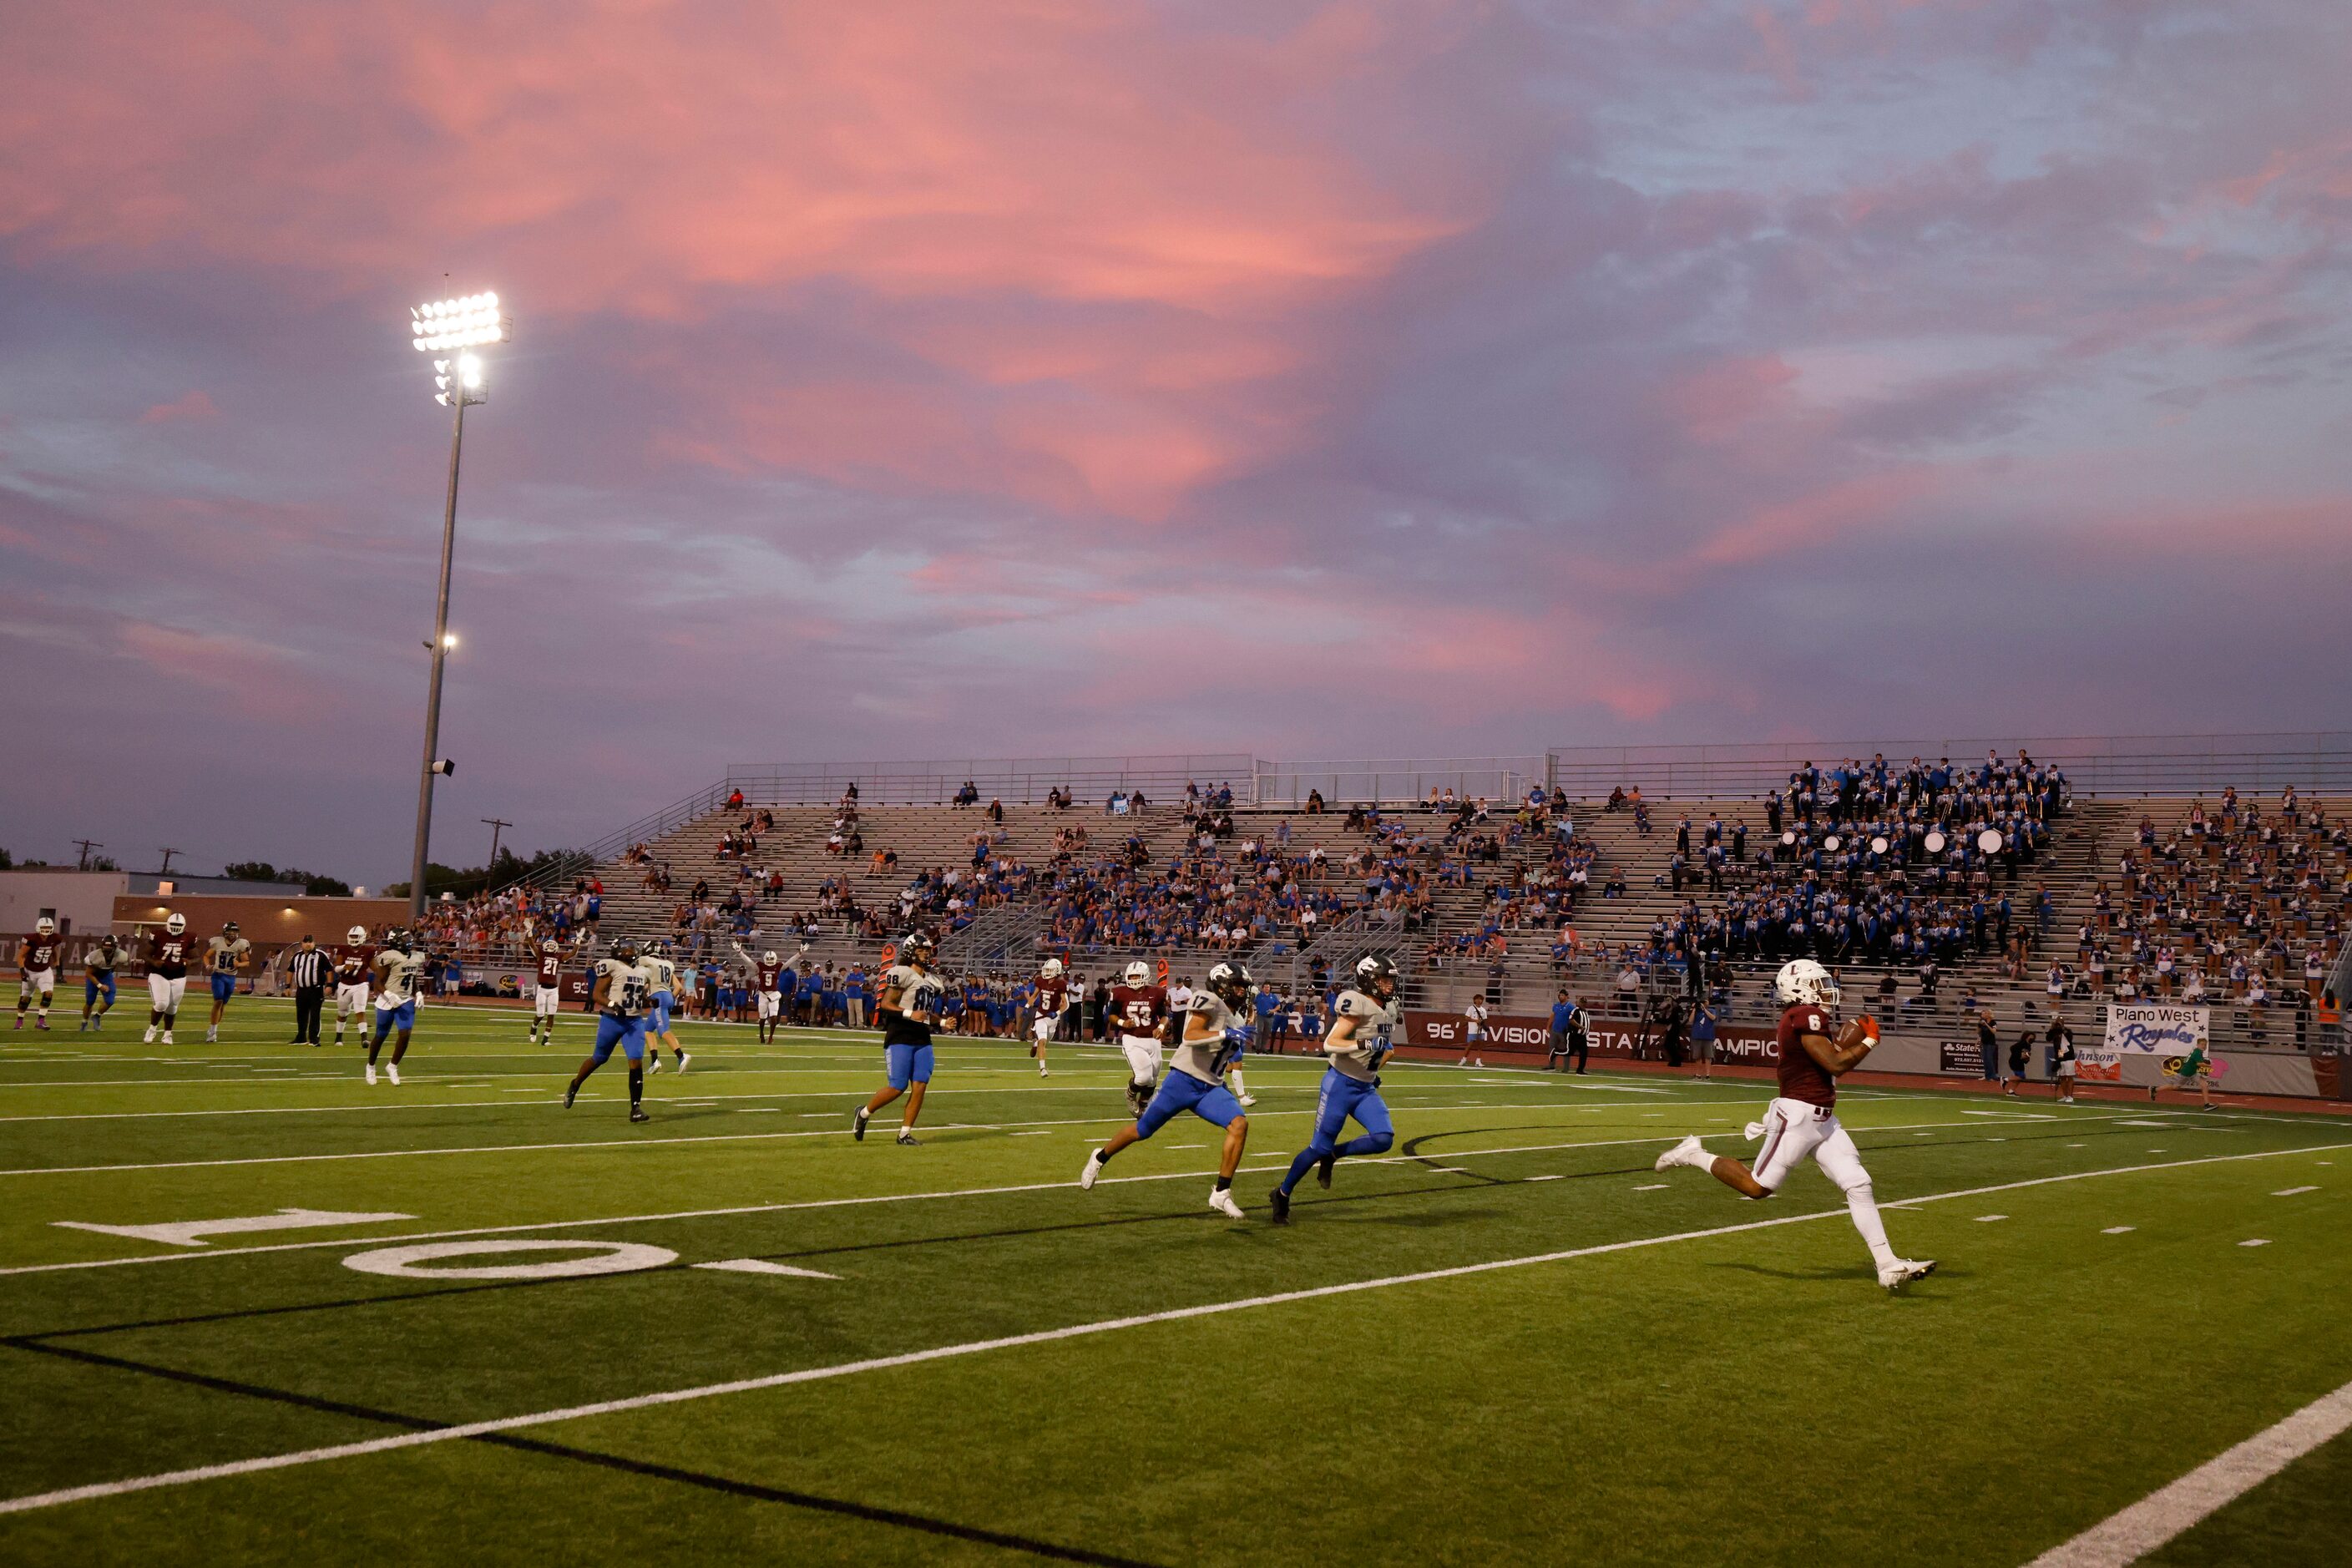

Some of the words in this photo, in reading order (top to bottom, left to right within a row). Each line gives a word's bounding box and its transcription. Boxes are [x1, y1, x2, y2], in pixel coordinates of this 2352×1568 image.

[161, 946, 183, 963] 75
[543, 959, 559, 975] 21
[658, 964, 671, 984] 18
[401, 974, 413, 991] 4
[765, 974, 772, 987] 9
[887, 974, 899, 985] 88
[622, 984, 645, 1009] 33
[1041, 994, 1051, 1010] 5
[1192, 994, 1209, 1009] 17
[1305, 1004, 1315, 1014] 22
[1340, 999, 1352, 1013] 2
[1126, 1006, 1151, 1027] 53
[1808, 1014, 1821, 1031] 6
[2116, 1008, 2155, 1021] Plano
[2158, 1009, 2200, 1023] West
[1427, 1021, 1460, 1039] 96'
[2118, 1022, 2195, 1053] Royales
[1955, 1043, 1975, 1052] State
[2076, 1050, 2114, 1062] hnson
